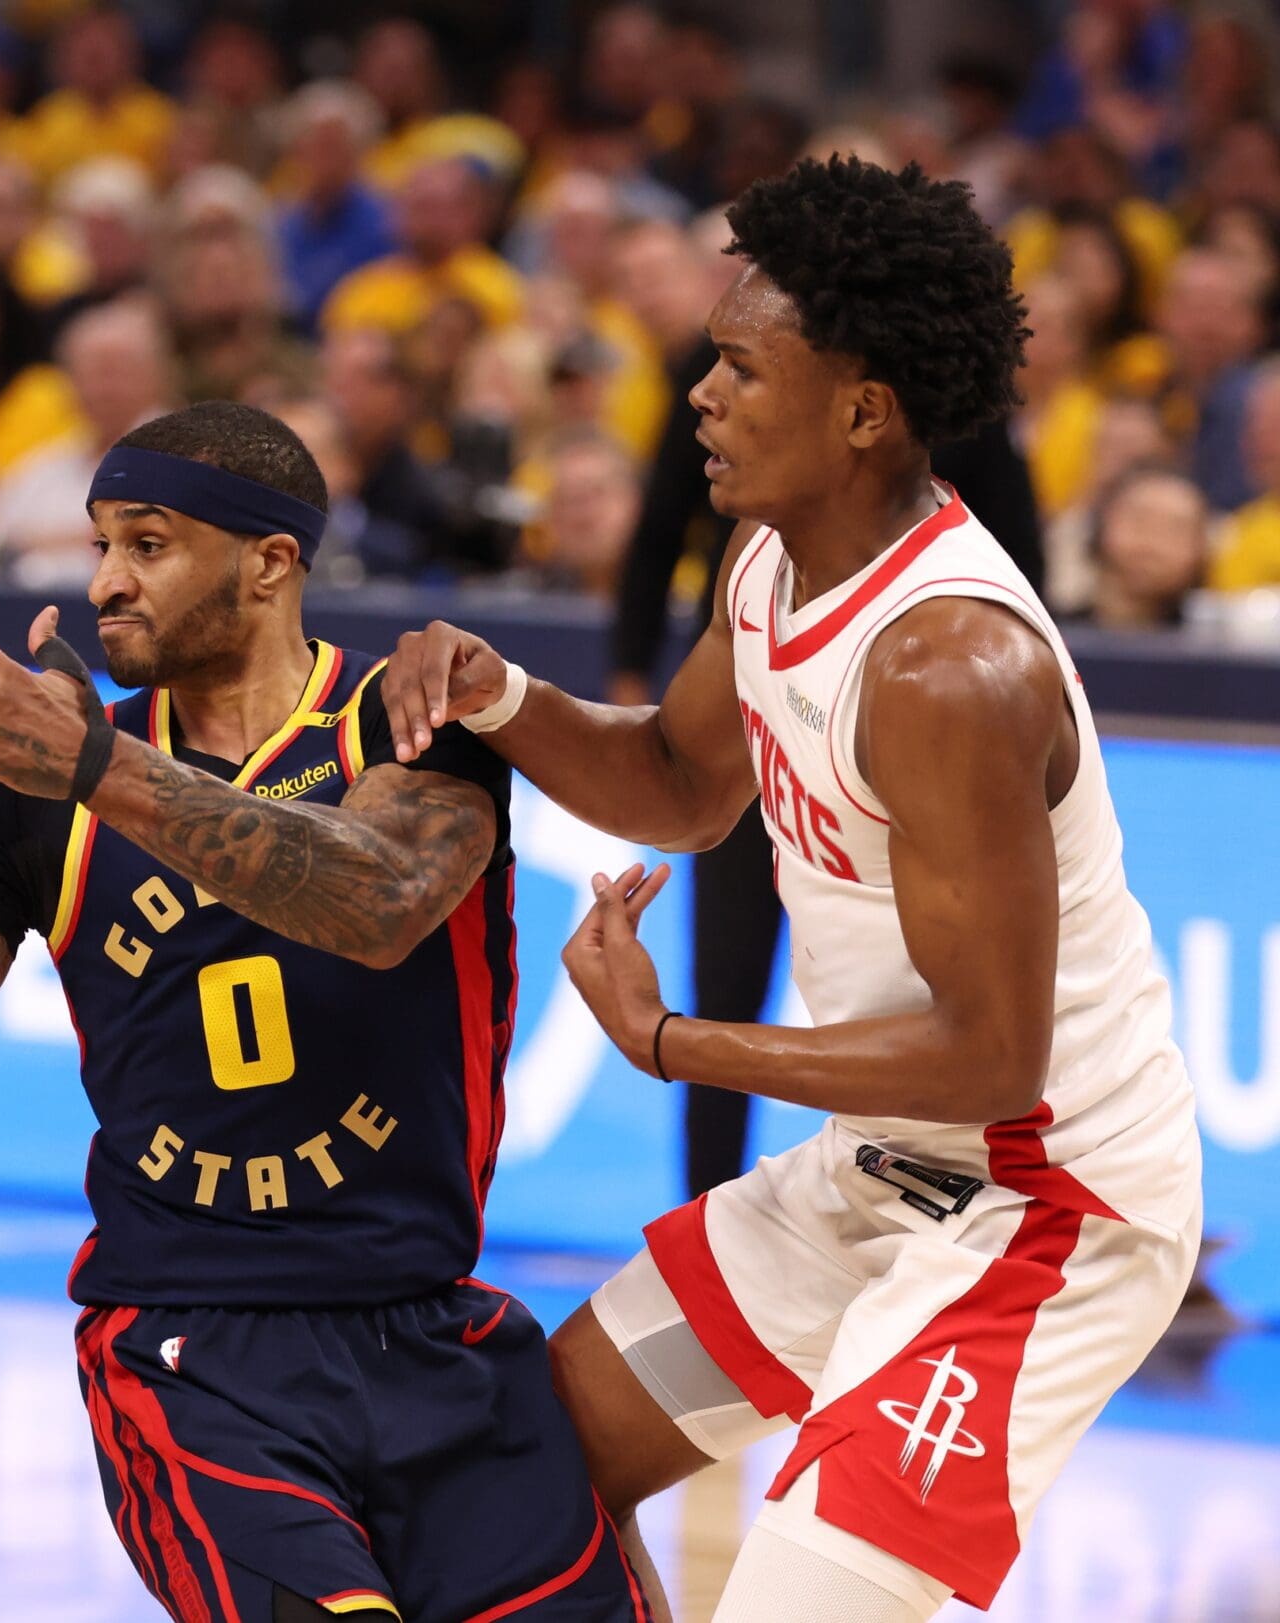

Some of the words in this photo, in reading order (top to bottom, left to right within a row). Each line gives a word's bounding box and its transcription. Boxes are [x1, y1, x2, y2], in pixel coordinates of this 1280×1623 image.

[255, 760, 338, 801] Rakuten
[197, 955, 295, 1090] 0
[137, 1093, 398, 1211] STATE
